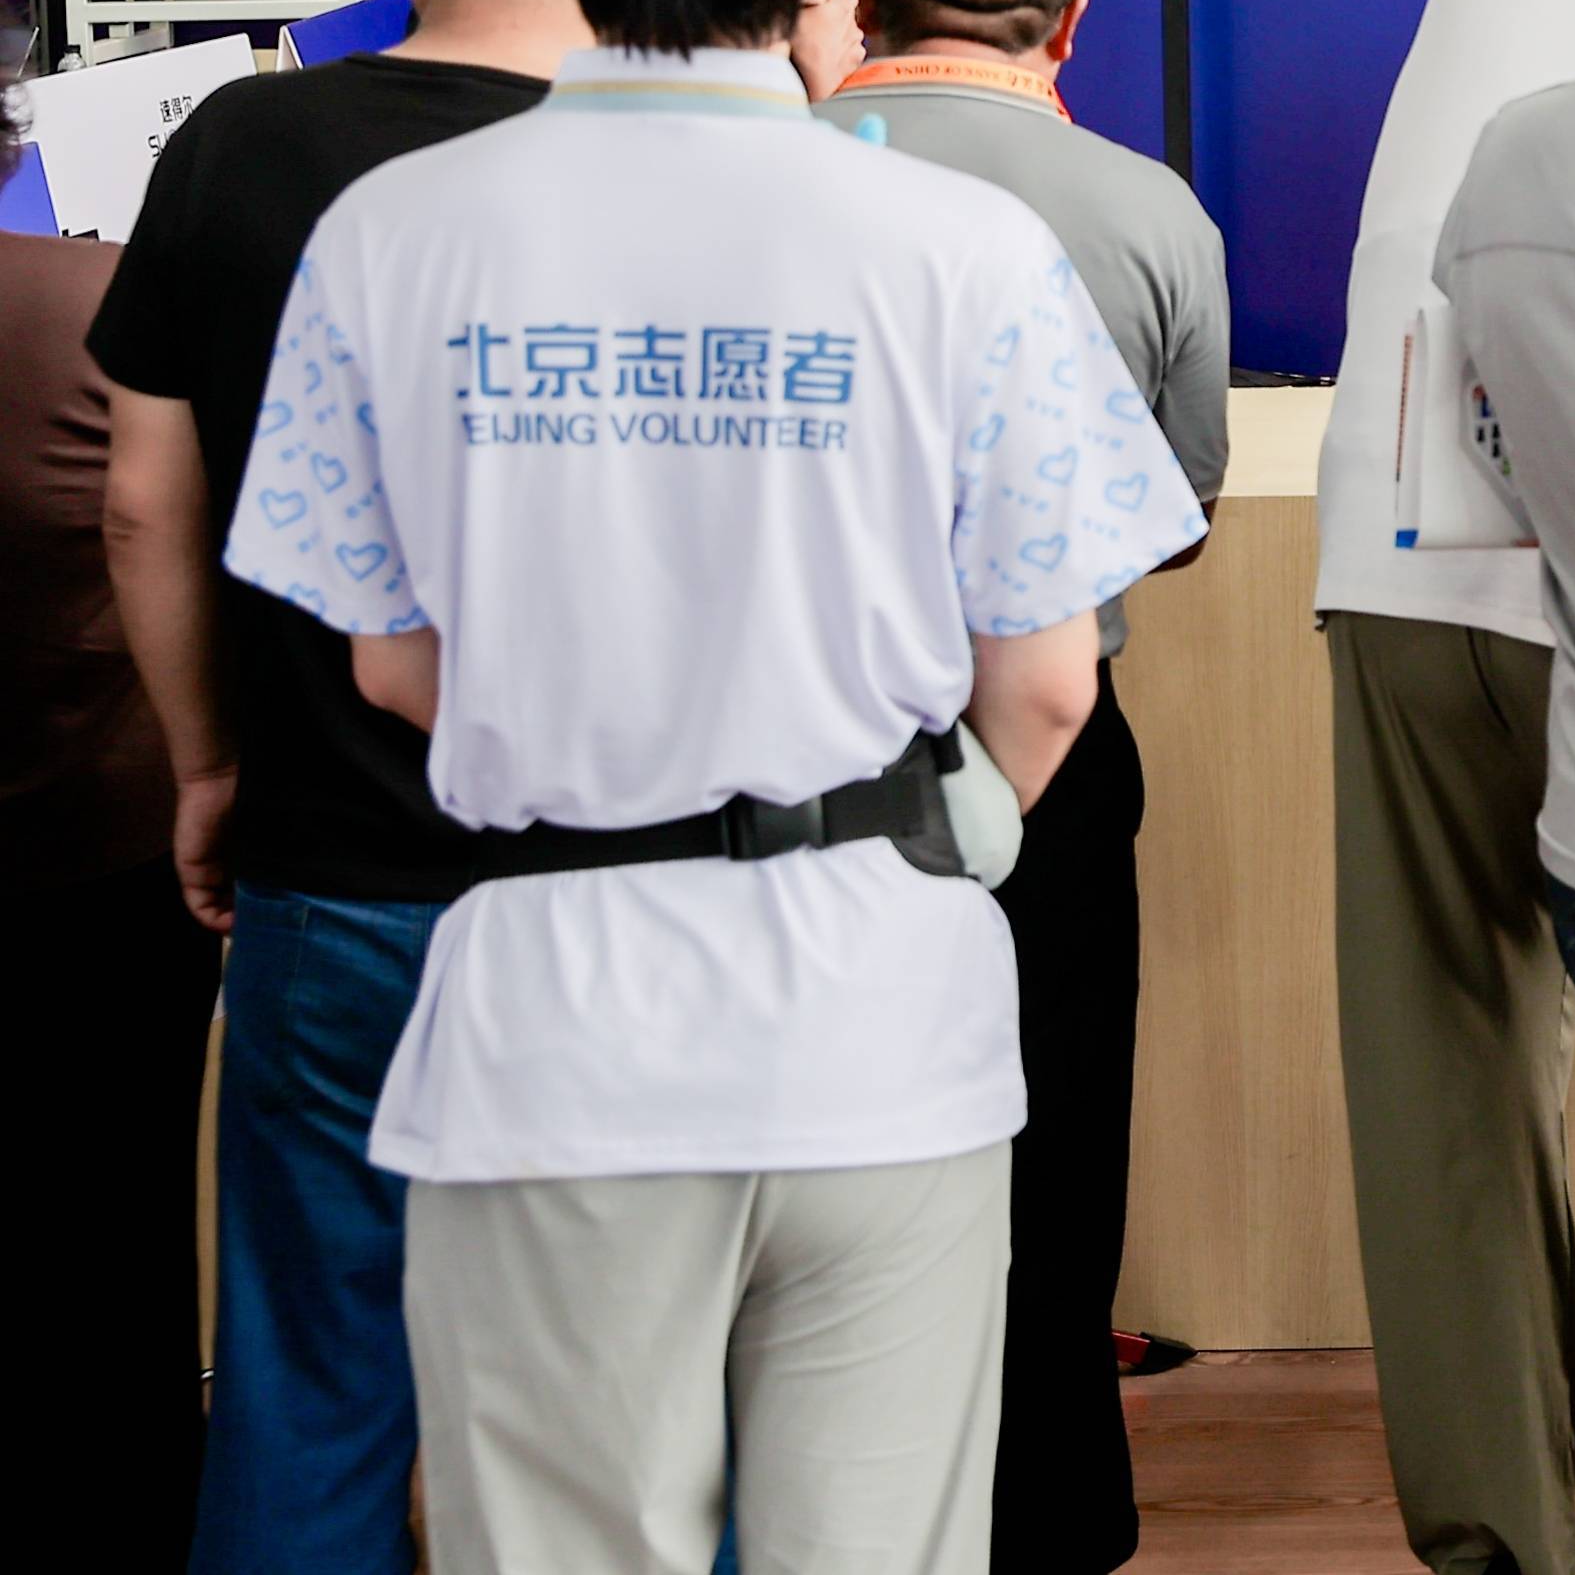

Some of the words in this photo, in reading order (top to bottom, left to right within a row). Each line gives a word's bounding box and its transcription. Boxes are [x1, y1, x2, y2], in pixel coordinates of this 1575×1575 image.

[447, 322, 857, 404] 北京志愿者
[464, 412, 597, 448] EIJING
[610, 414, 847, 450] VOLUNTEER
